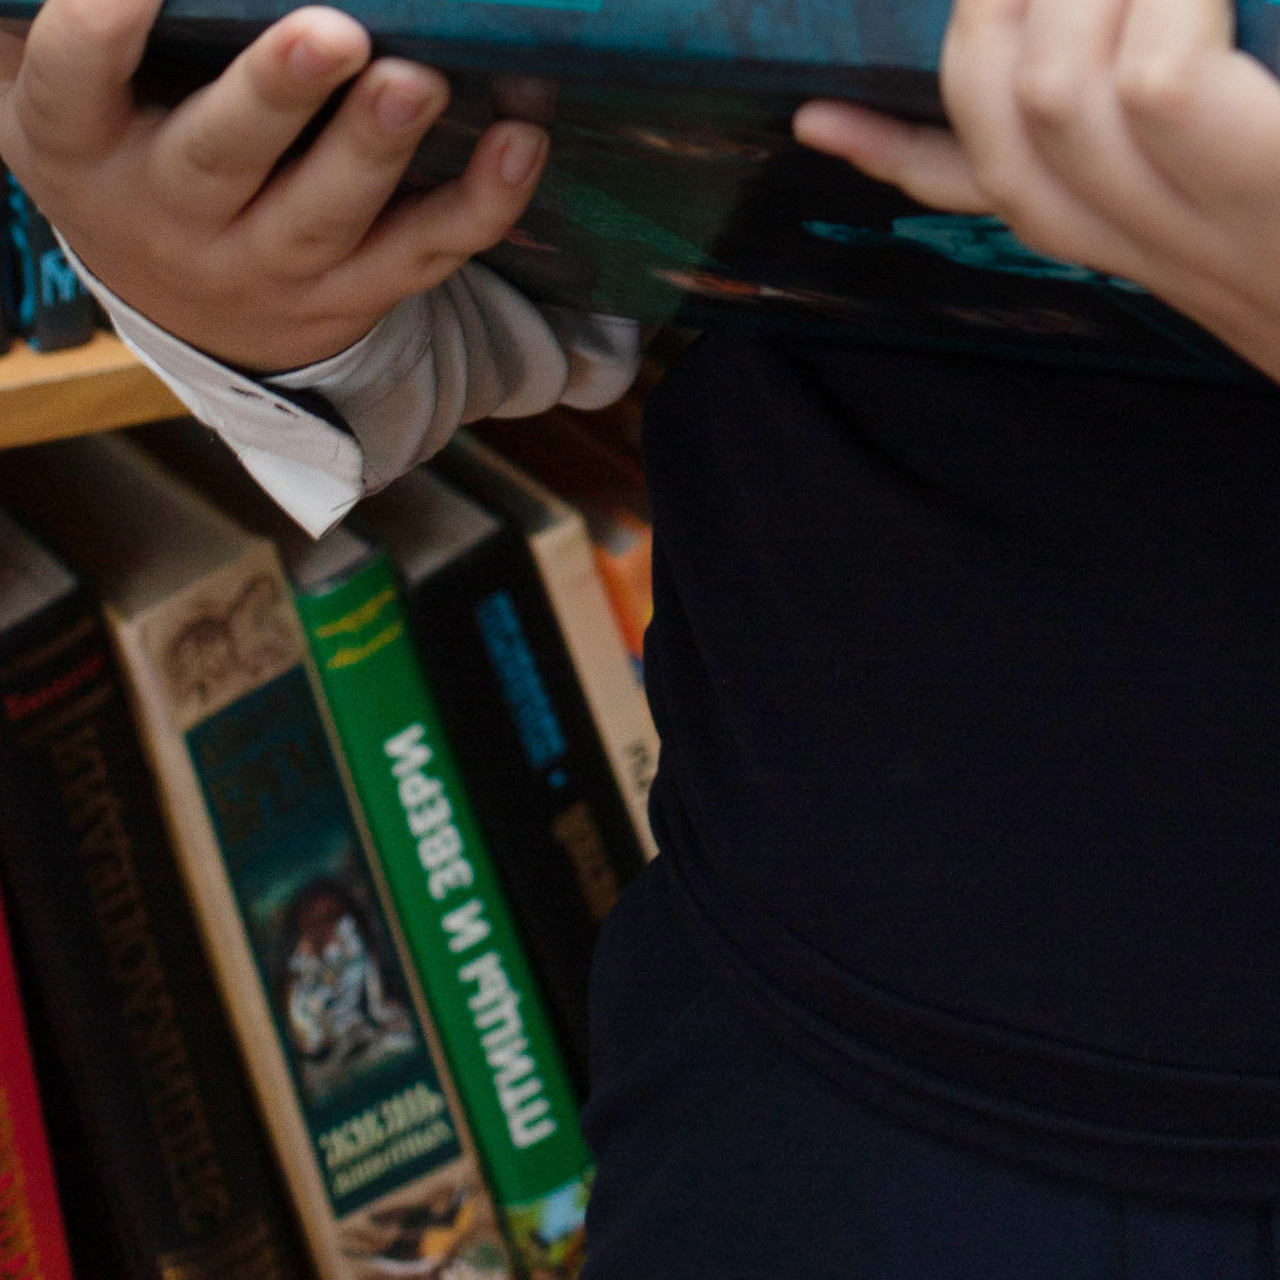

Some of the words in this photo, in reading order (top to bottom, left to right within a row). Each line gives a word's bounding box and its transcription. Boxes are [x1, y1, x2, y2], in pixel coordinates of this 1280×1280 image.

[382, 721, 473, 903] ЗВЕРИ
[440, 897, 493, 957] И
[457, 950, 560, 1152] ПТИЦЫ
